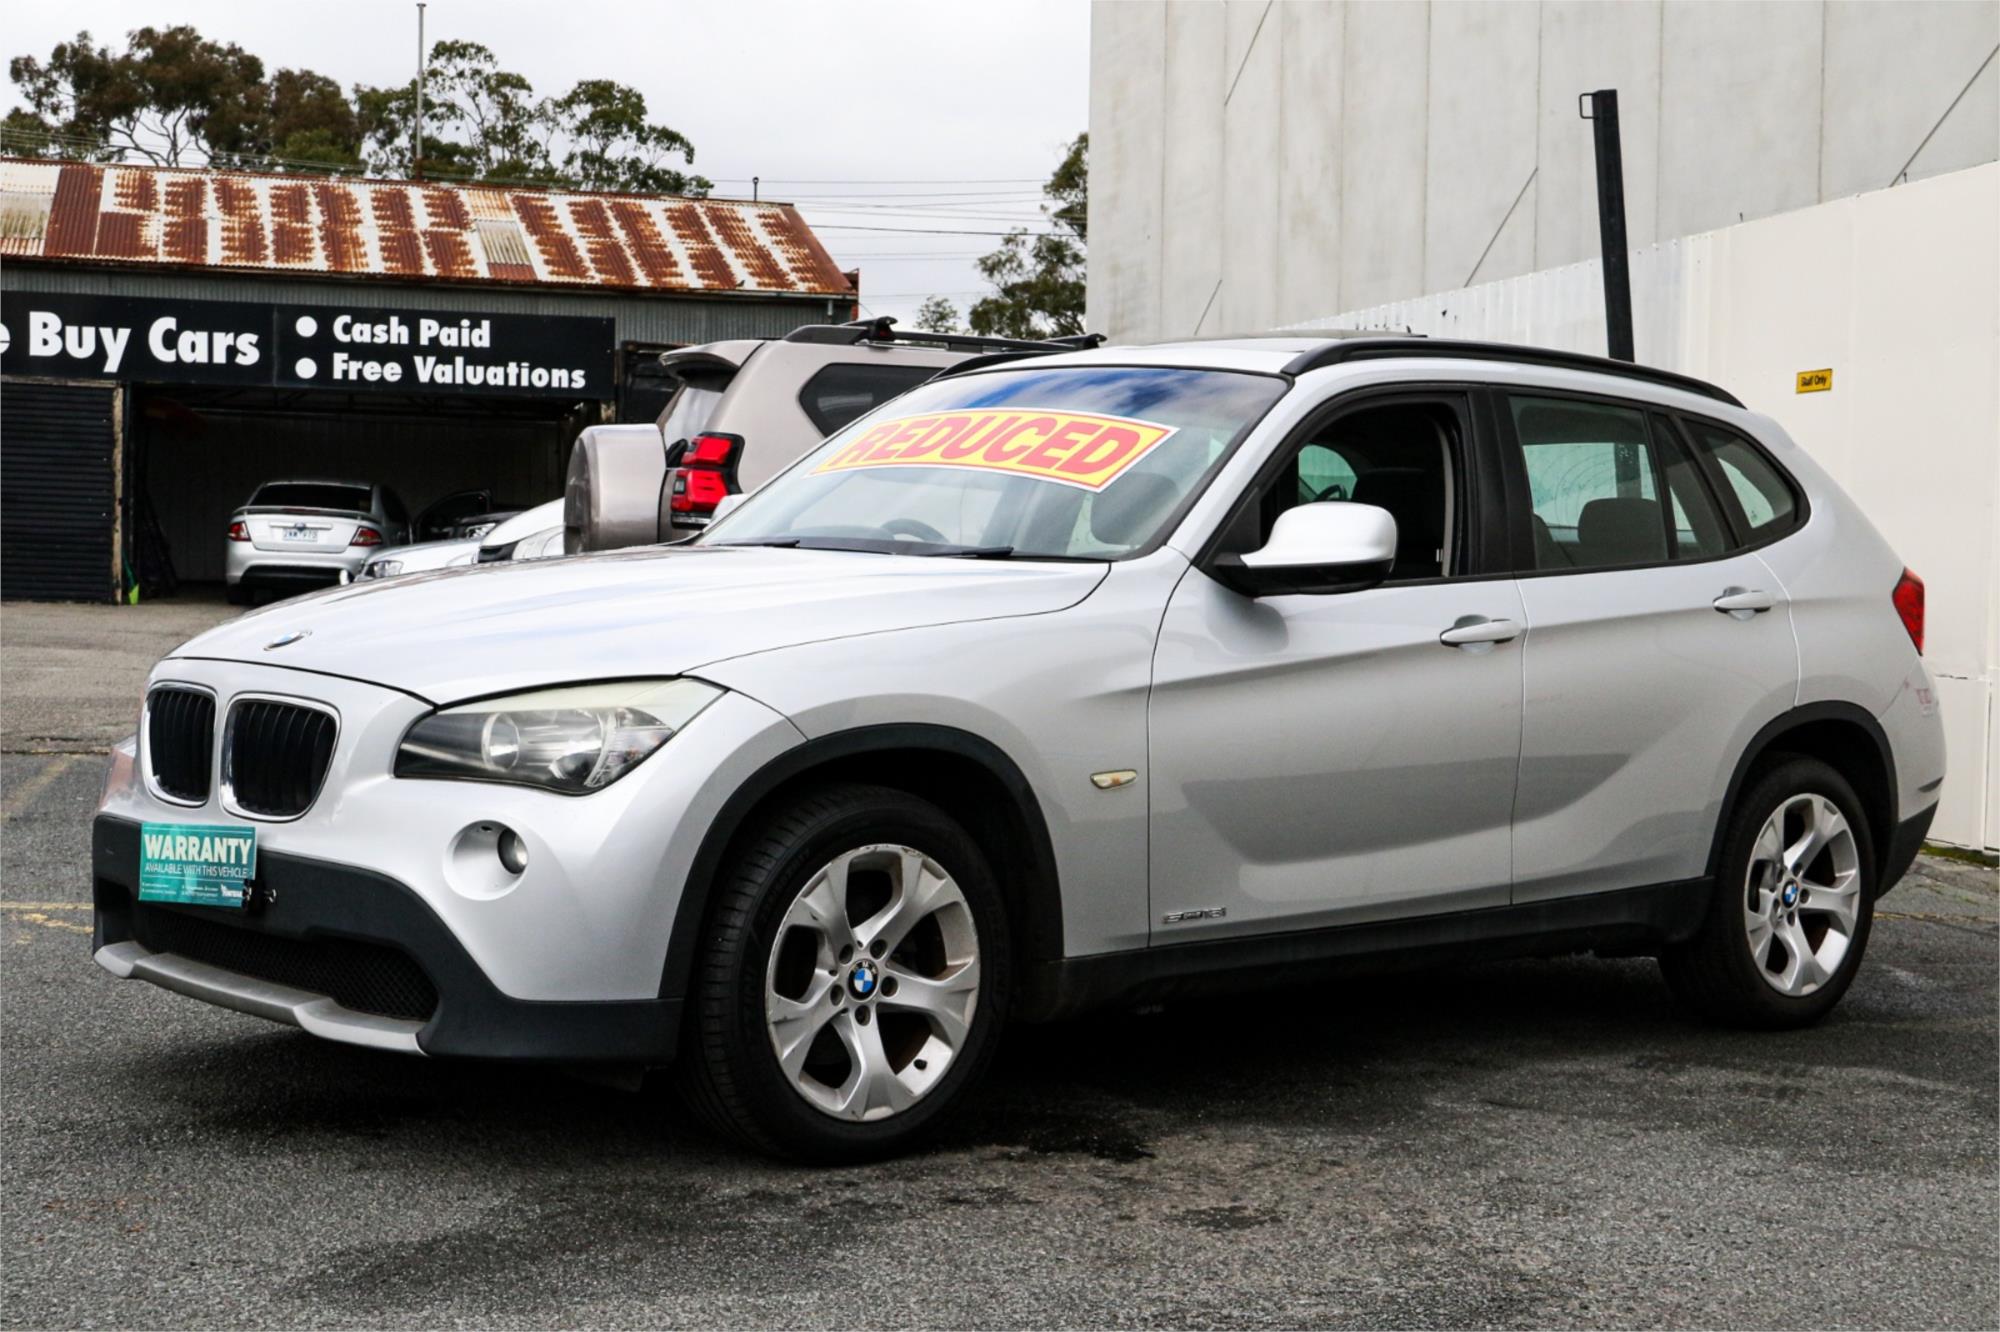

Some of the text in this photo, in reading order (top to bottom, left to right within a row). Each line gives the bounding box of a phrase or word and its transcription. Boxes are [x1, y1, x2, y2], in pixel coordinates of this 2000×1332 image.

[29, 311, 132, 373] Buy
[148, 316, 260, 366] Cars
[333, 315, 491, 348] Cash Paid
[333, 352, 586, 389] Free Valuations
[829, 415, 1141, 475] REDUCED
[144, 834, 253, 864] WARRANTY
[145, 863, 248, 879] AVAILABLE WITH THIS VEHICLE
